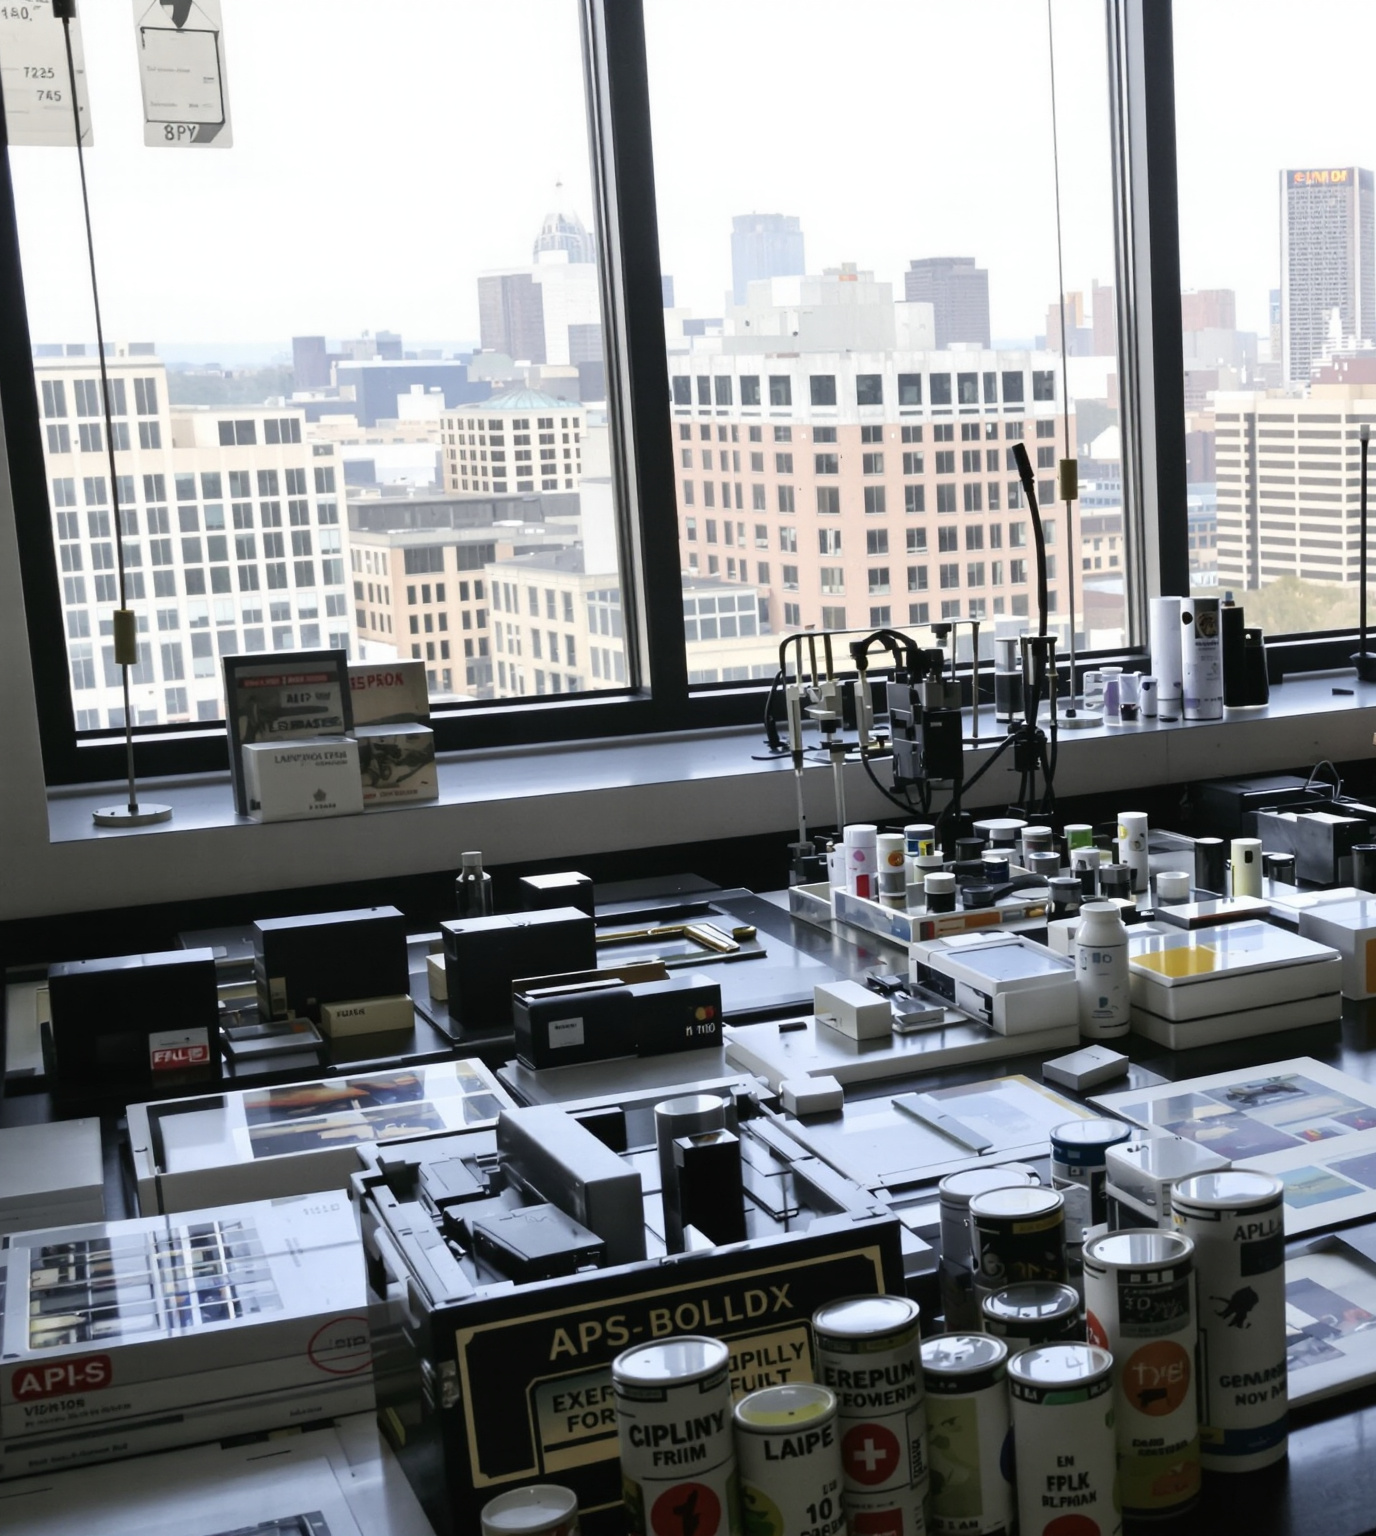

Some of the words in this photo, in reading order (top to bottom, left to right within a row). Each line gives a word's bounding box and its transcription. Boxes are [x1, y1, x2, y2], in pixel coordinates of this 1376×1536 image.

[548, 1282, 795, 1362] APS-BOLLDX
[824, 1359, 916, 1390] EREPUM
[629, 1408, 725, 1448] CIPLINY
[763, 1424, 835, 1461] LAIPE
[1056, 1455, 1075, 1468] EN
[806, 1497, 834, 1525] 10
